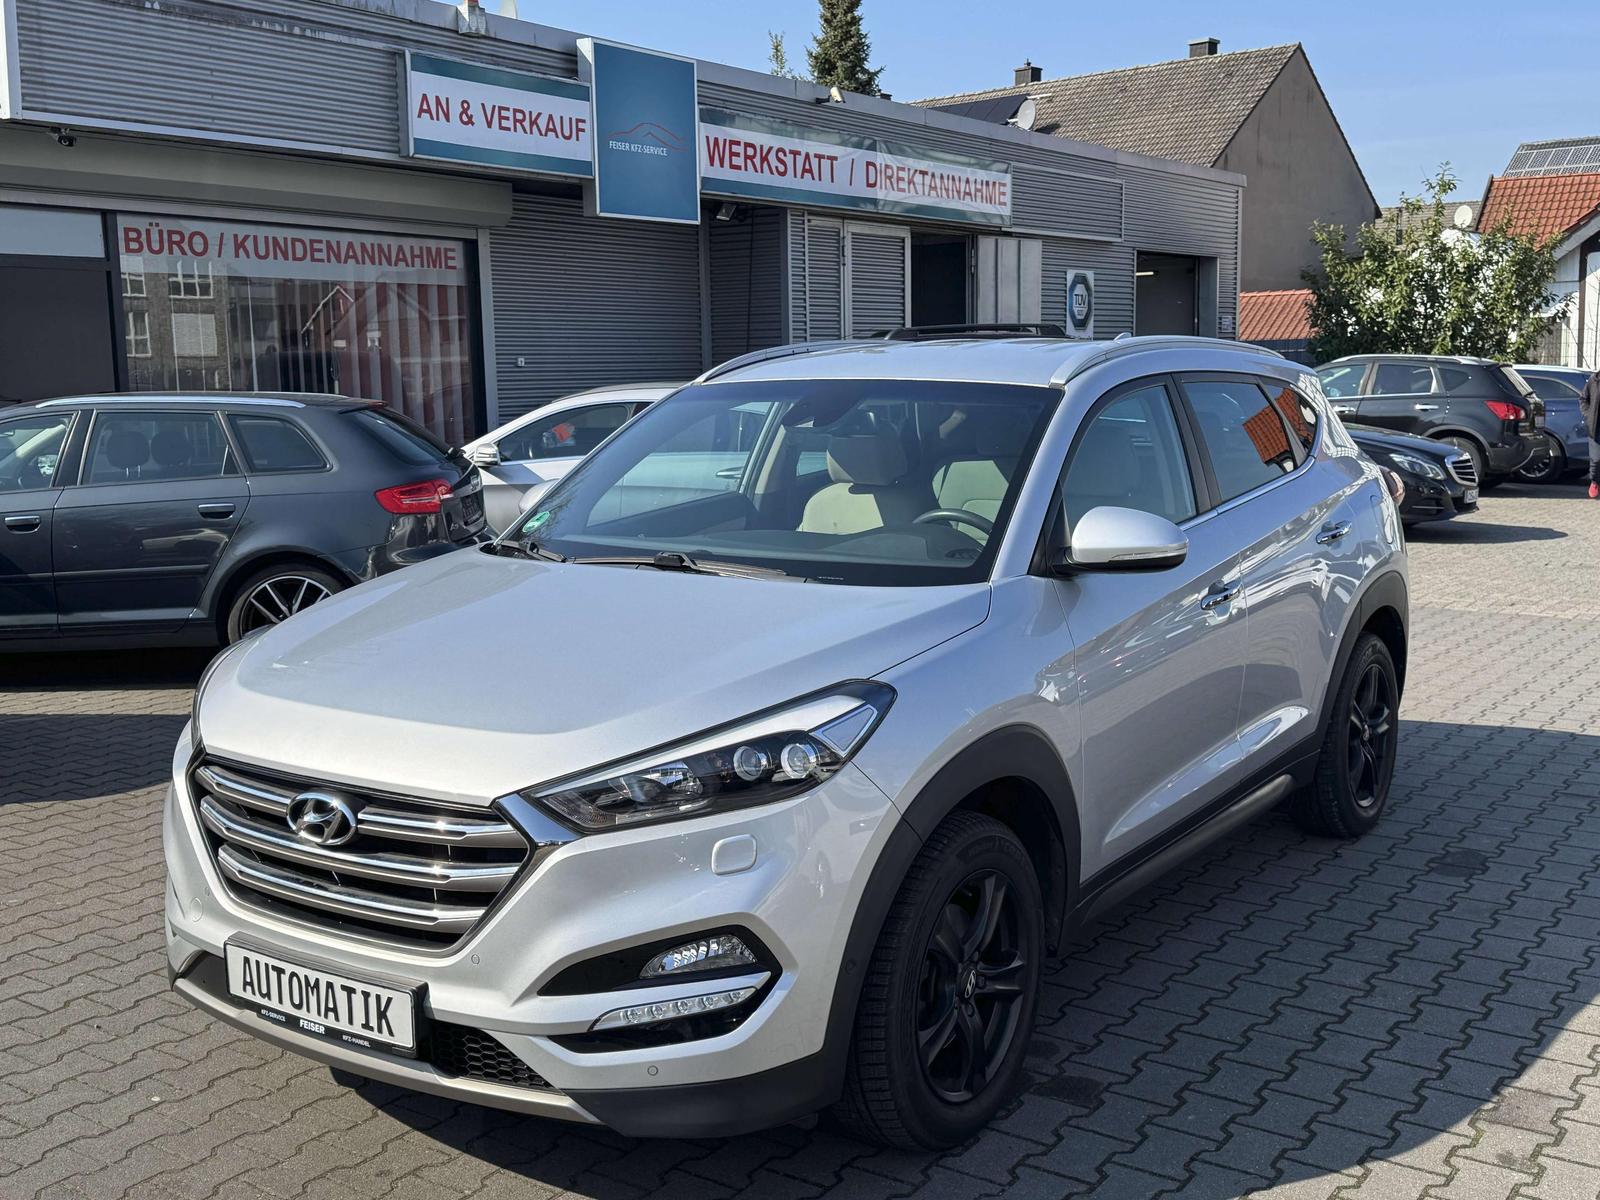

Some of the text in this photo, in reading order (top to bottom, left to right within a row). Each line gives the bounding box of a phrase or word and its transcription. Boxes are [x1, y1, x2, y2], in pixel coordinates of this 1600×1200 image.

[417, 93, 587, 142] AN & VERKAUF
[609, 140, 668, 156] FEISER KFZ-SERVICE
[705, 135, 1008, 207] WERKSTATT / DIREKTANNAHME
[123, 222, 458, 271] BÜRO / KUNDENANNAHME
[242, 955, 395, 1038] AUTOMATIK
[299, 1019, 326, 1035] FEISER
[342, 1034, 371, 1048] KFZ-HANDEL
